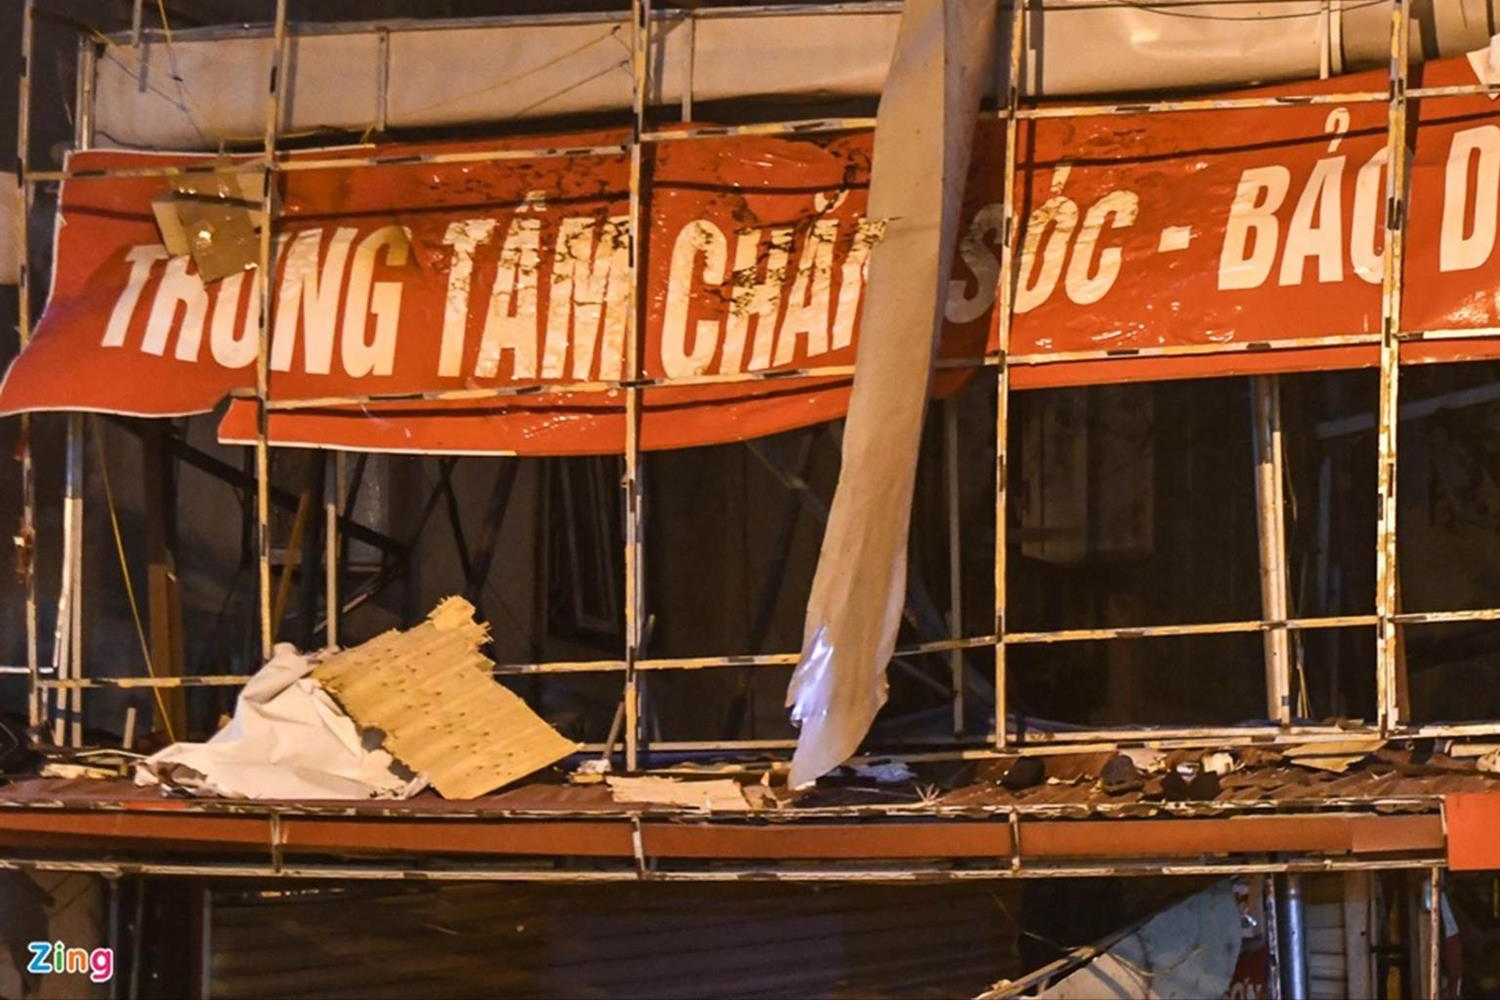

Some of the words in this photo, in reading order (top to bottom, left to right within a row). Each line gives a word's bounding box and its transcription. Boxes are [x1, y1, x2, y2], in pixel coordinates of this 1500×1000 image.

[101, 224, 410, 378] TRUNG
[438, 190, 632, 380] TÂM
[944, 164, 1139, 324] SÓC
[1218, 107, 1412, 290] BẢO
